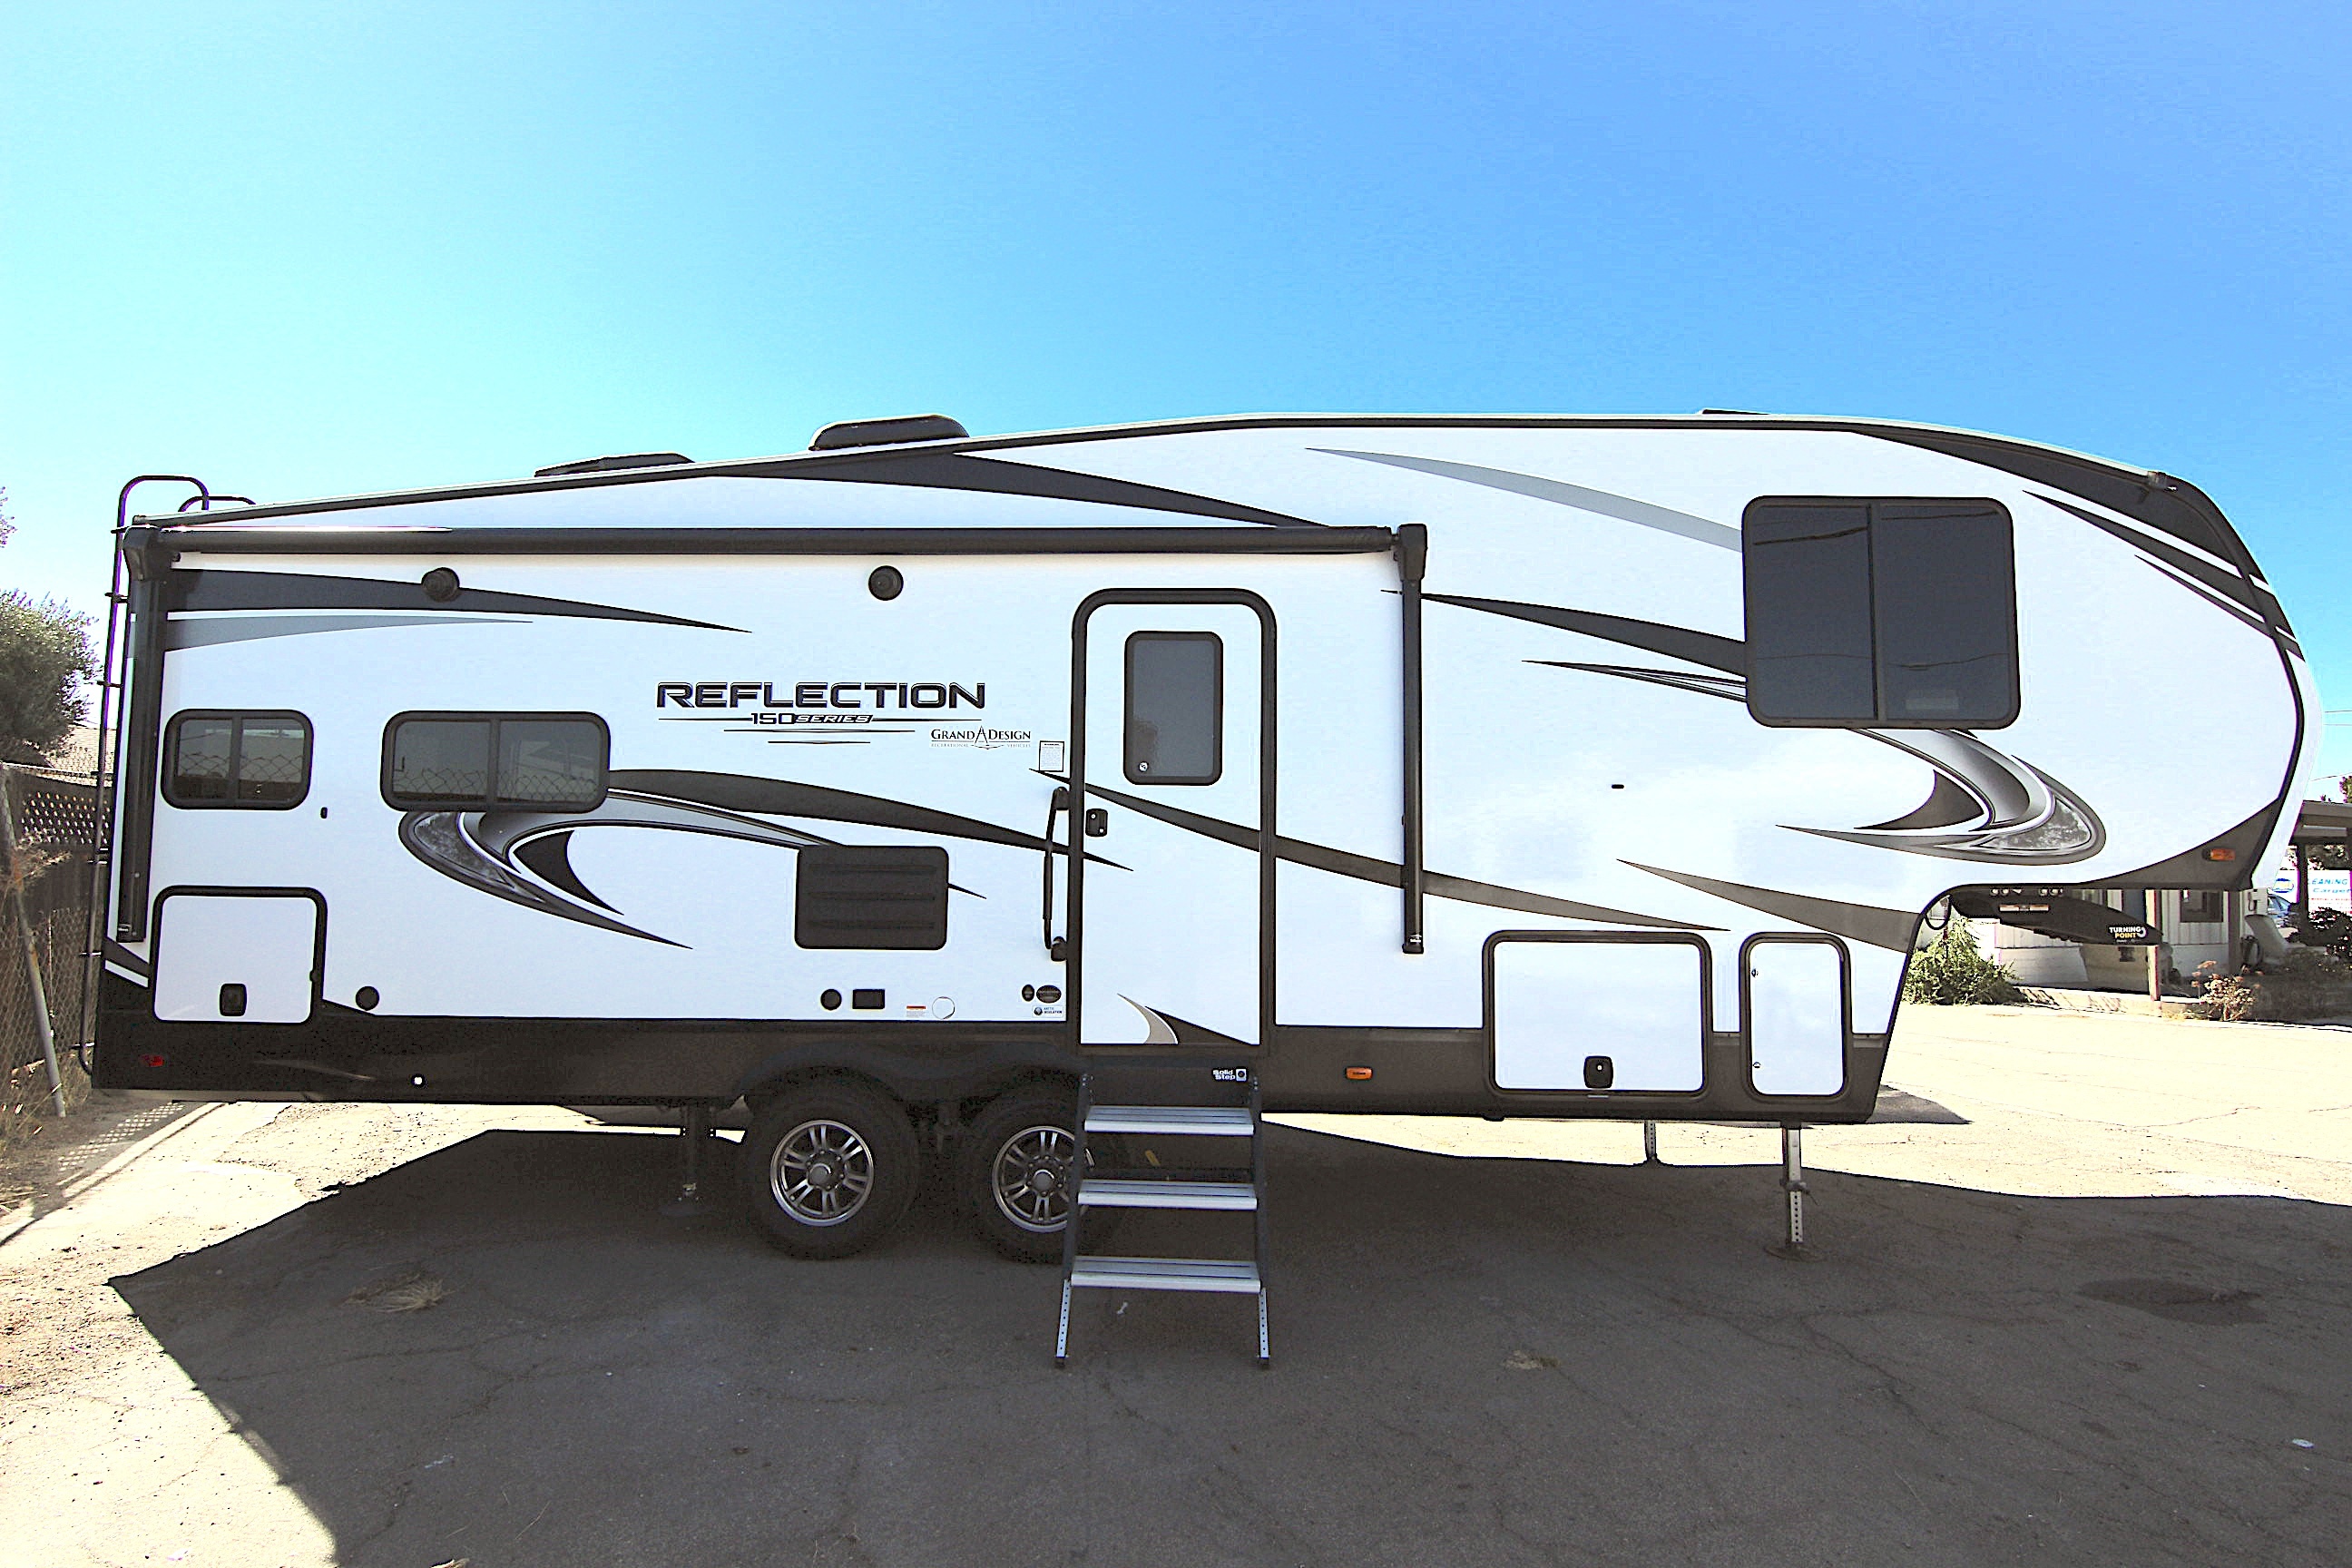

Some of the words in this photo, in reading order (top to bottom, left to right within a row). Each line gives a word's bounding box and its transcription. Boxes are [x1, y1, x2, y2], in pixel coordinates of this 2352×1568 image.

[656, 681, 985, 709] REFLECTION
[751, 712, 795, 724] 150
[795, 714, 869, 723] SERIES
[931, 729, 975, 740] GRAND
[988, 729, 1031, 740] DESIGN
